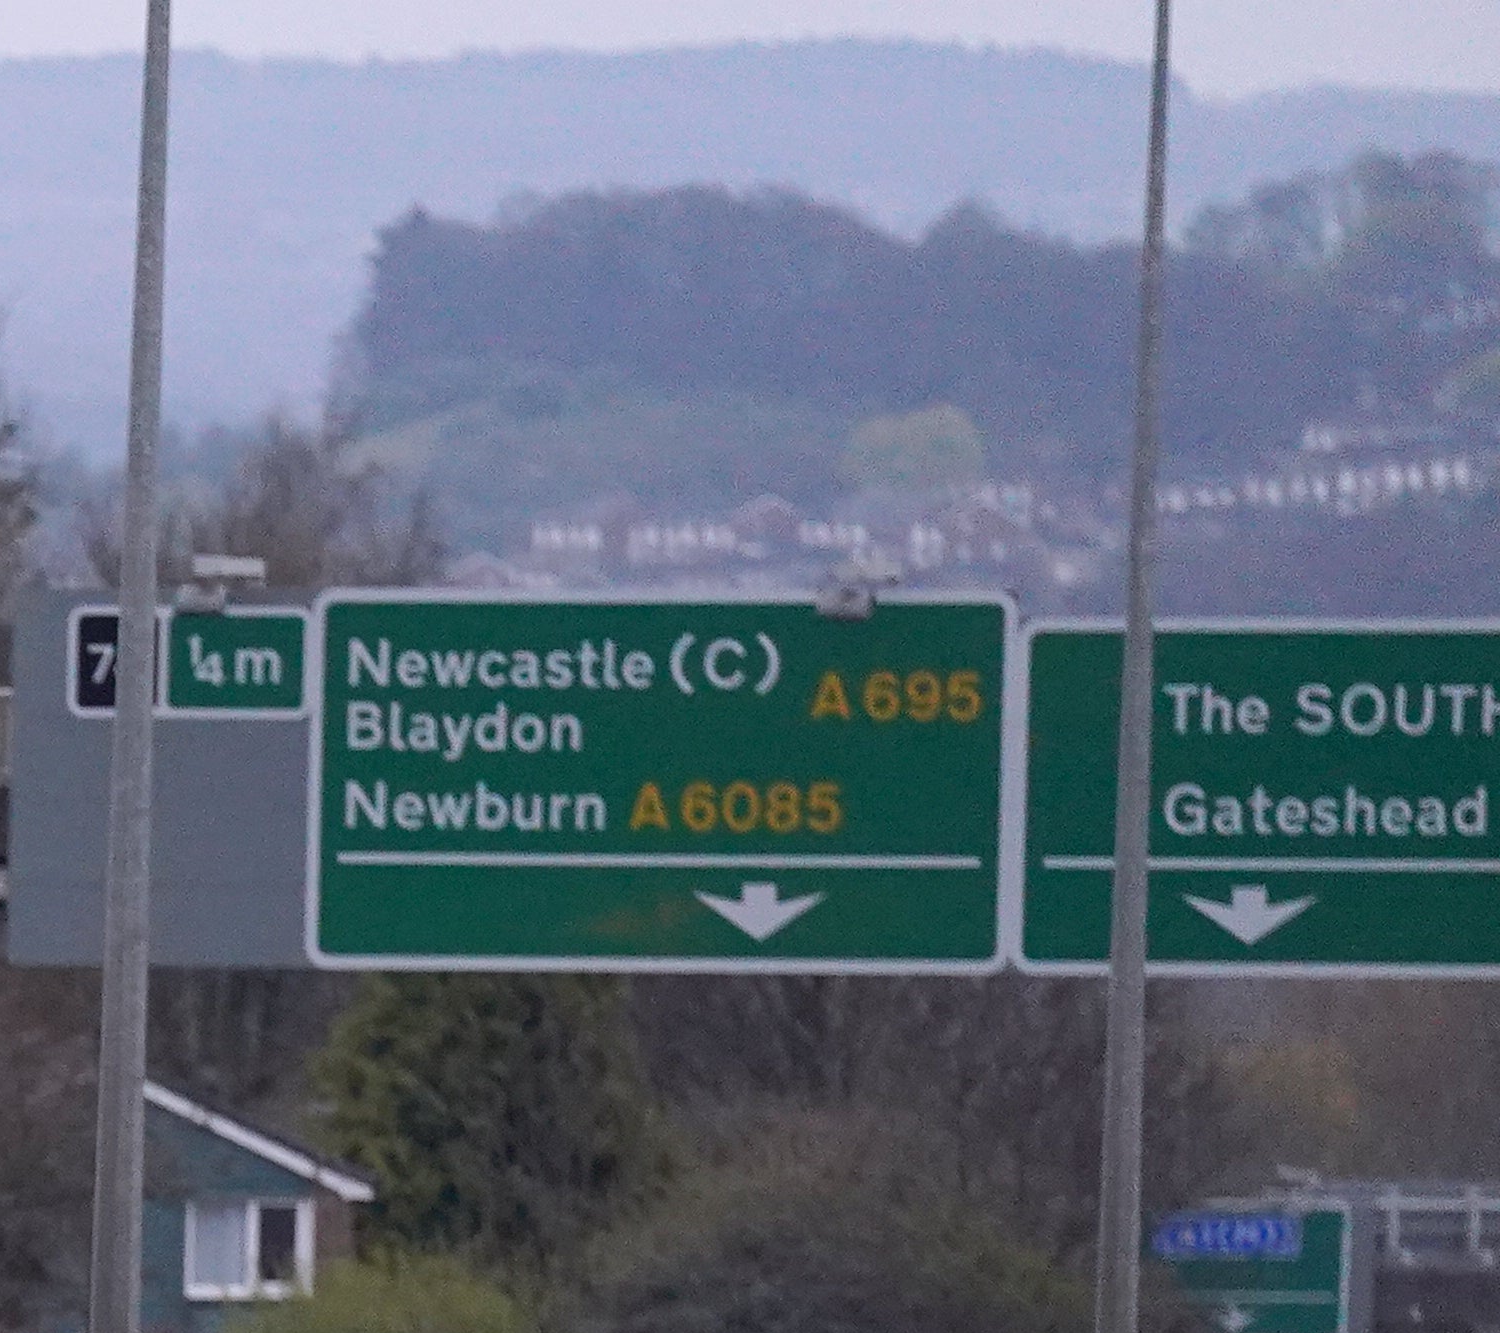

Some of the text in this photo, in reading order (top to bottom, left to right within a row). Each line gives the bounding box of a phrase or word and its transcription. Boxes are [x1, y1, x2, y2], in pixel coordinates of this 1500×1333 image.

[347, 631, 782, 697] Newcastle (C)
[809, 669, 985, 724] A695
[1161, 682, 1271, 736] The
[346, 700, 584, 763] Blaydon
[343, 778, 843, 834] Newburn A6085
[1162, 781, 1490, 837] Gateshead
